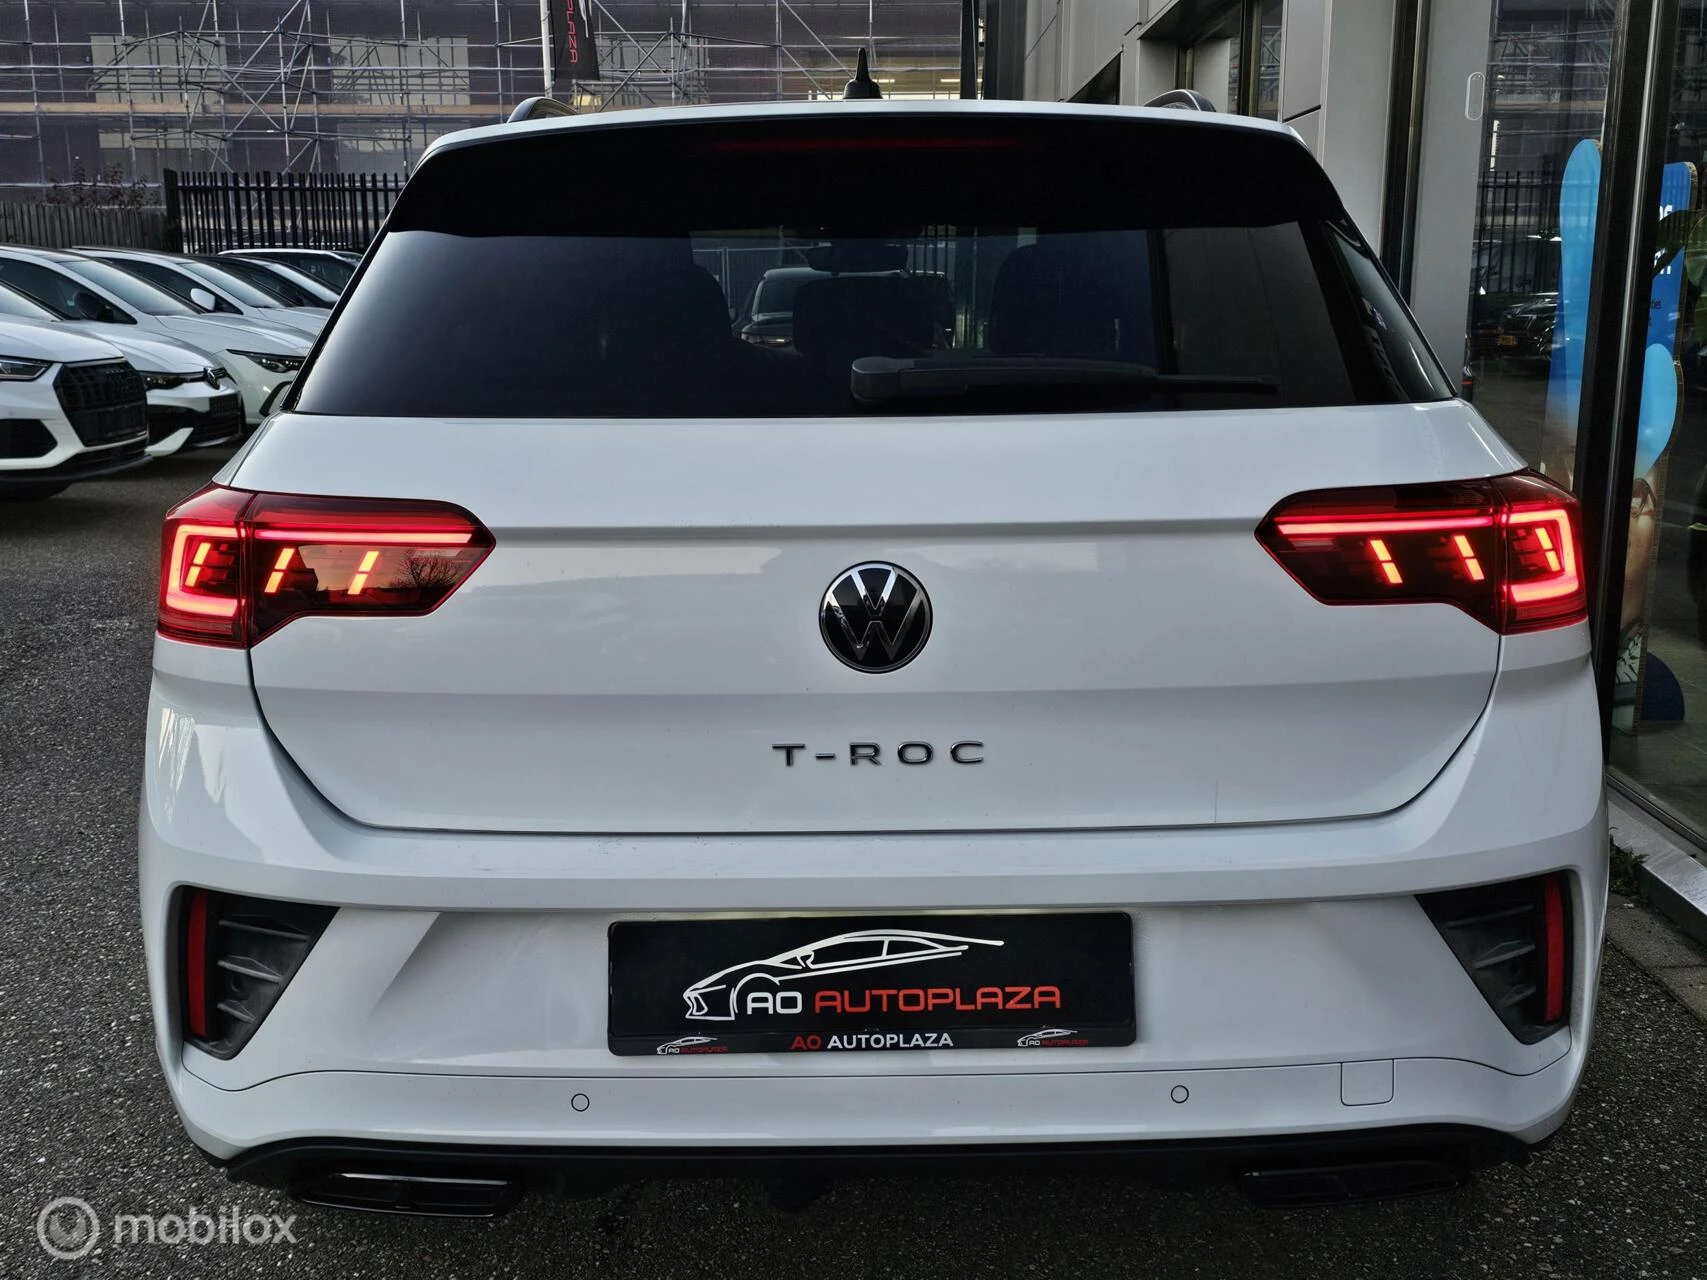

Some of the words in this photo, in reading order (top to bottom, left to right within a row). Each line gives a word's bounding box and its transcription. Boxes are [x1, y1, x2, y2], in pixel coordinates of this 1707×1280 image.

[772, 741, 984, 767] T-ROC
[746, 991, 802, 1015] AO
[814, 986, 1061, 1014] AUTOPLAZA
[791, 1035, 821, 1050] AO
[827, 1032, 954, 1049] AUTOPLAZA
